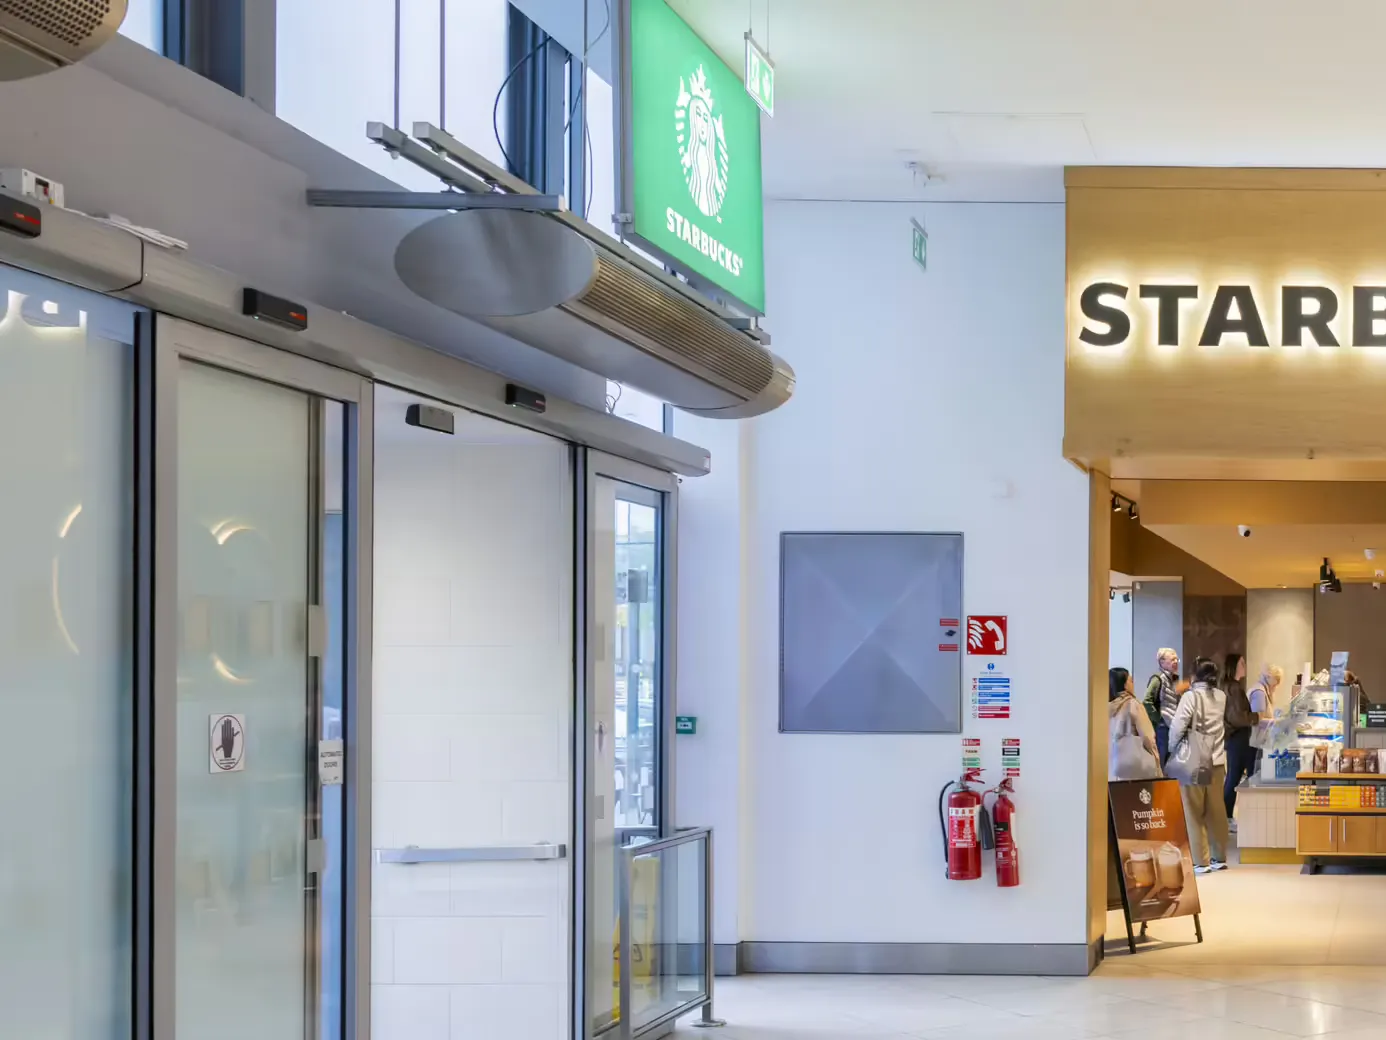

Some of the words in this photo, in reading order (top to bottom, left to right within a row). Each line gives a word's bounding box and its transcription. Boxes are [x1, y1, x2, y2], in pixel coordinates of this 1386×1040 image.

[666, 207, 741, 277] STARBUCKS
[1132, 808, 1164, 819] Pumpkin
[1150, 820, 1166, 829] back
